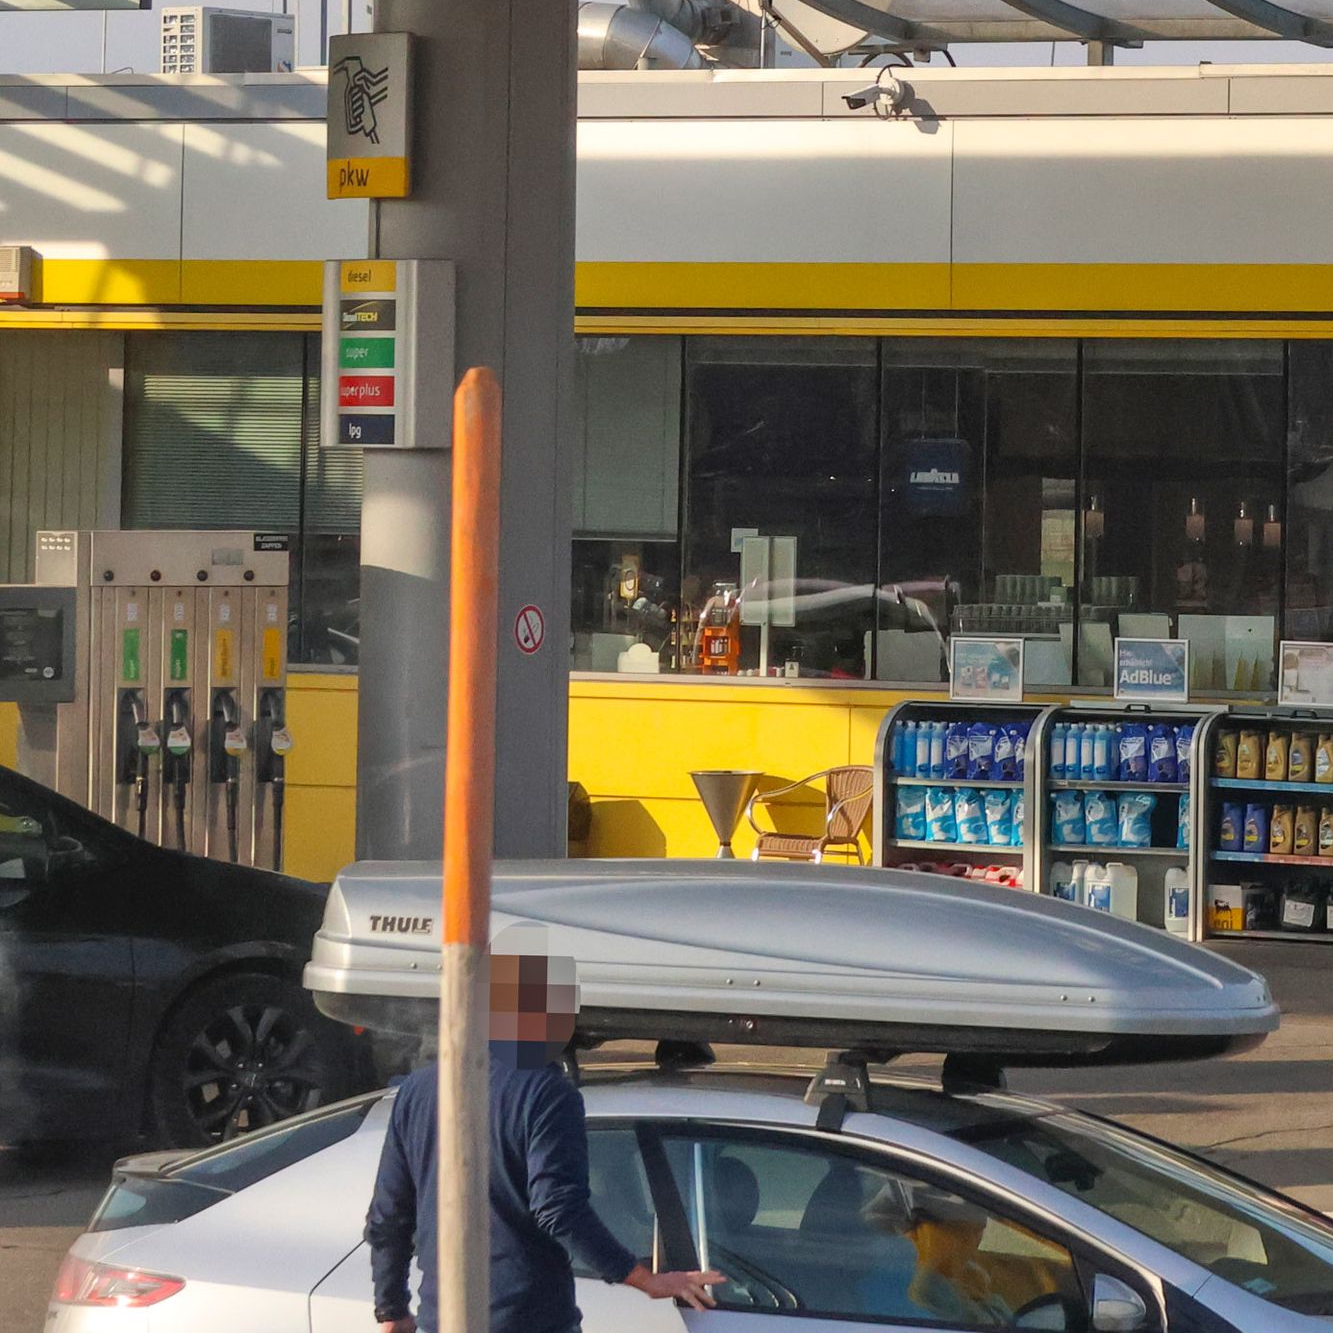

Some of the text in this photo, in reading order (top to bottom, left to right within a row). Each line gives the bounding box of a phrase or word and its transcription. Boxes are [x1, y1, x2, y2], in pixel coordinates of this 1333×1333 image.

[339, 160, 369, 194] pkw
[349, 423, 362, 438] lpg
[370, 915, 433, 934] THULE
